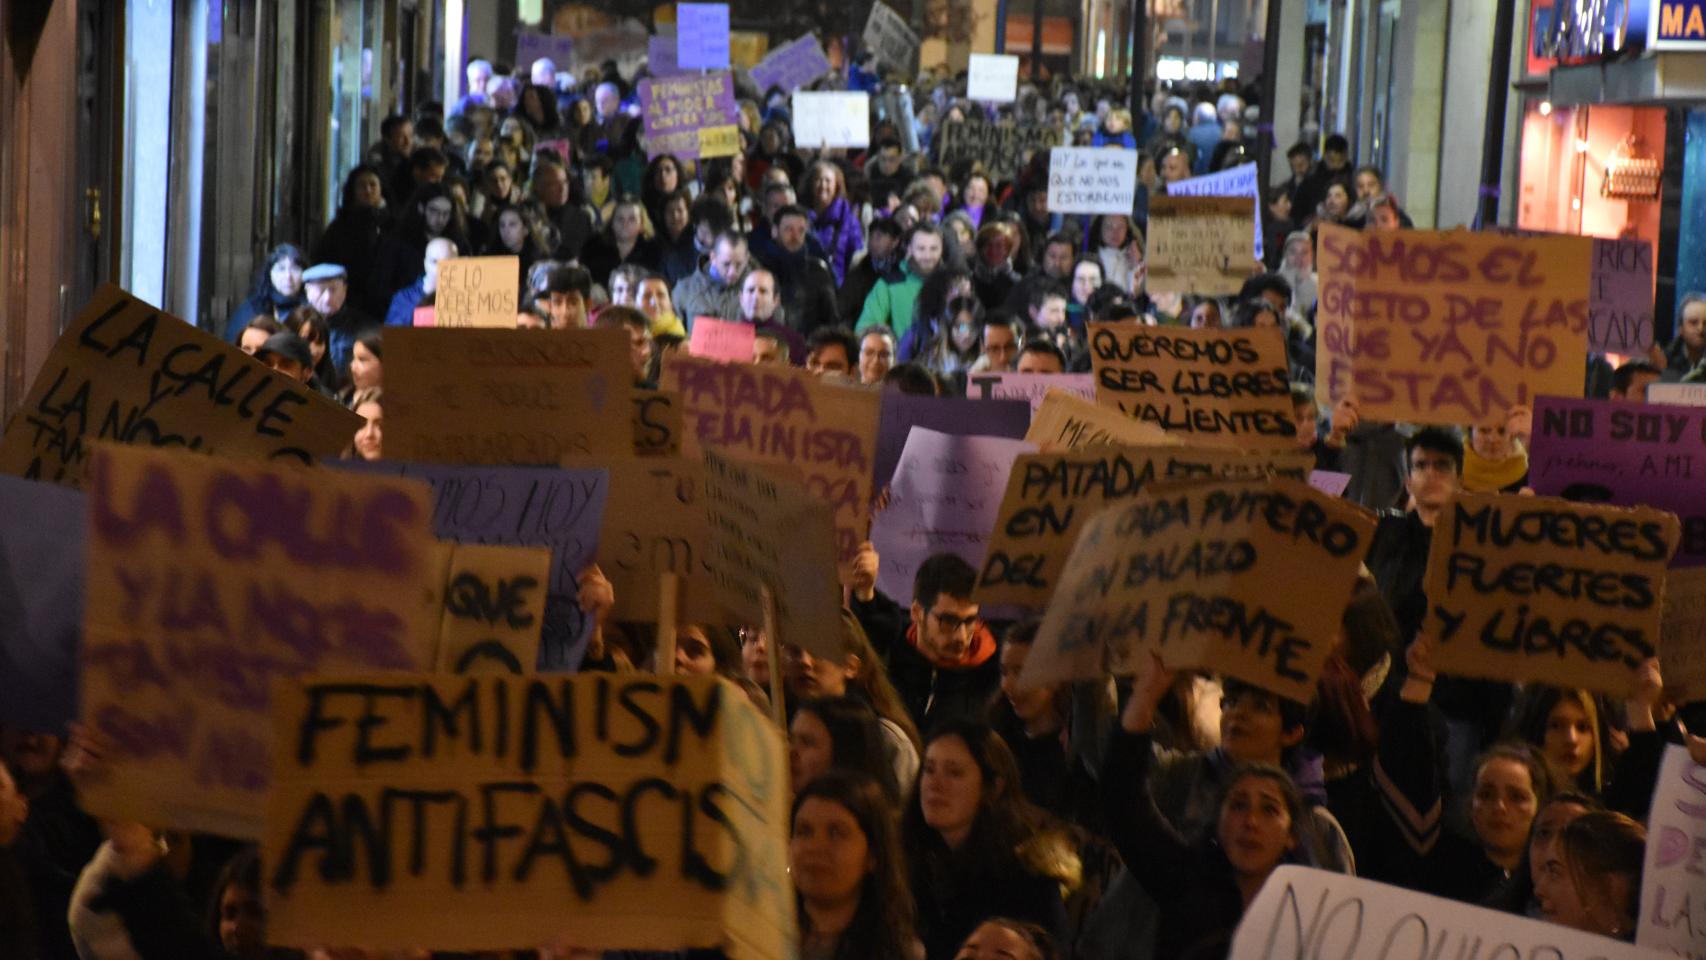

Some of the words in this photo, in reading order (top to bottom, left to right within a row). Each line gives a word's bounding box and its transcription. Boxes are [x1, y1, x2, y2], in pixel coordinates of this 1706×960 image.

[1322, 235, 1470, 283] SOMOS
[1477, 247, 1547, 289] EL
[1322, 281, 1432, 326] GRITO
[1443, 293, 1504, 329] DE
[1520, 298, 1589, 334] LAS
[80, 298, 160, 368] LA
[160, 342, 310, 437] CALLE
[1093, 328, 1259, 364] QUEREMOS
[1323, 323, 1390, 361] QUE
[1411, 319, 1473, 363] YA
[1485, 325, 1558, 371] NO
[669, 361, 818, 424] PATADA
[1099, 366, 1165, 394] SER
[1172, 368, 1291, 399] LIBRES
[1543, 409, 1595, 440] NO
[1610, 411, 1689, 443] SOY
[1005, 503, 1074, 538] EN
[1201, 489, 1359, 557] PUTERO
[1453, 501, 1669, 562] MUJERES
[979, 551, 1047, 589] DEL
[1447, 553, 1655, 609] FUERTES
[444, 571, 538, 630] QUE
[1434, 605, 1468, 642] Y
[1159, 591, 1312, 683] FRENTE
